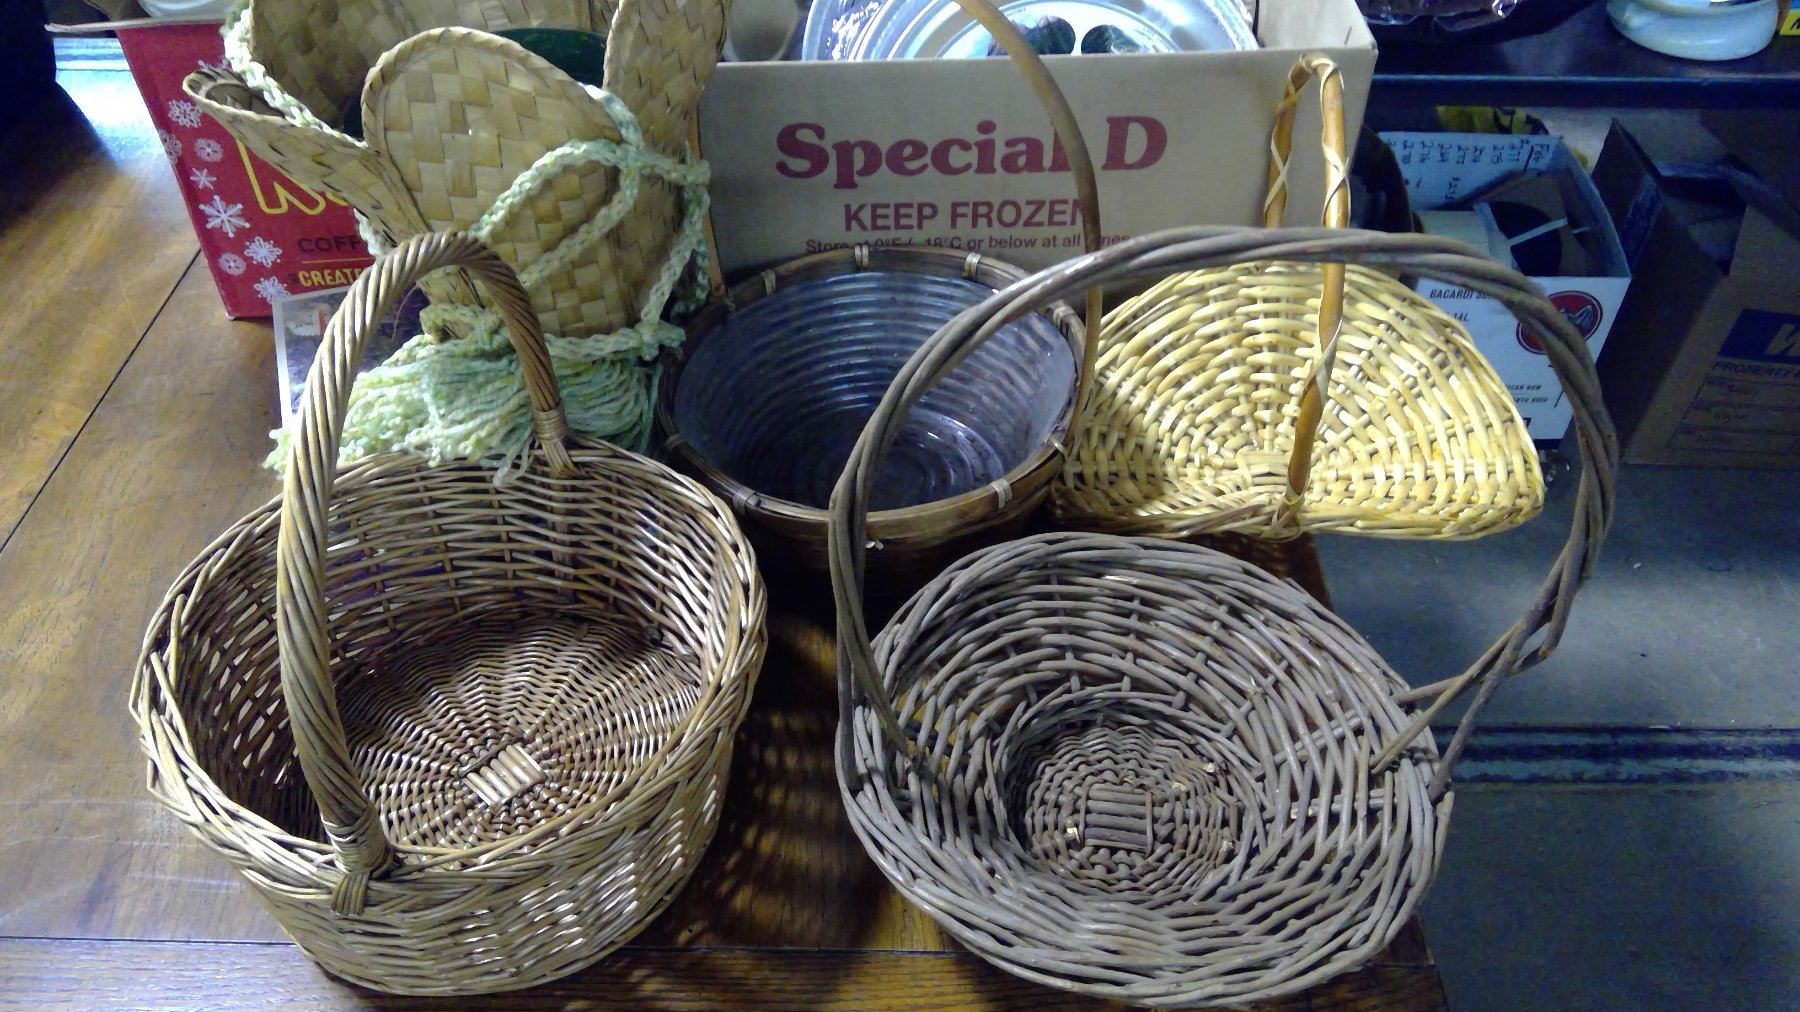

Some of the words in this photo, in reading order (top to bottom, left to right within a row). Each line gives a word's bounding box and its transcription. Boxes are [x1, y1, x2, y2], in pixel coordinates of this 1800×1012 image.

[776, 119, 1072, 190] Special
[1101, 115, 1168, 171] D
[844, 202, 939, 232] KEEP
[298, 236, 362, 252] COFF
[967, 238, 984, 251] or
[989, 235, 1036, 248] below
[1042, 234, 1057, 248] at
[1062, 234, 1080, 248] all
